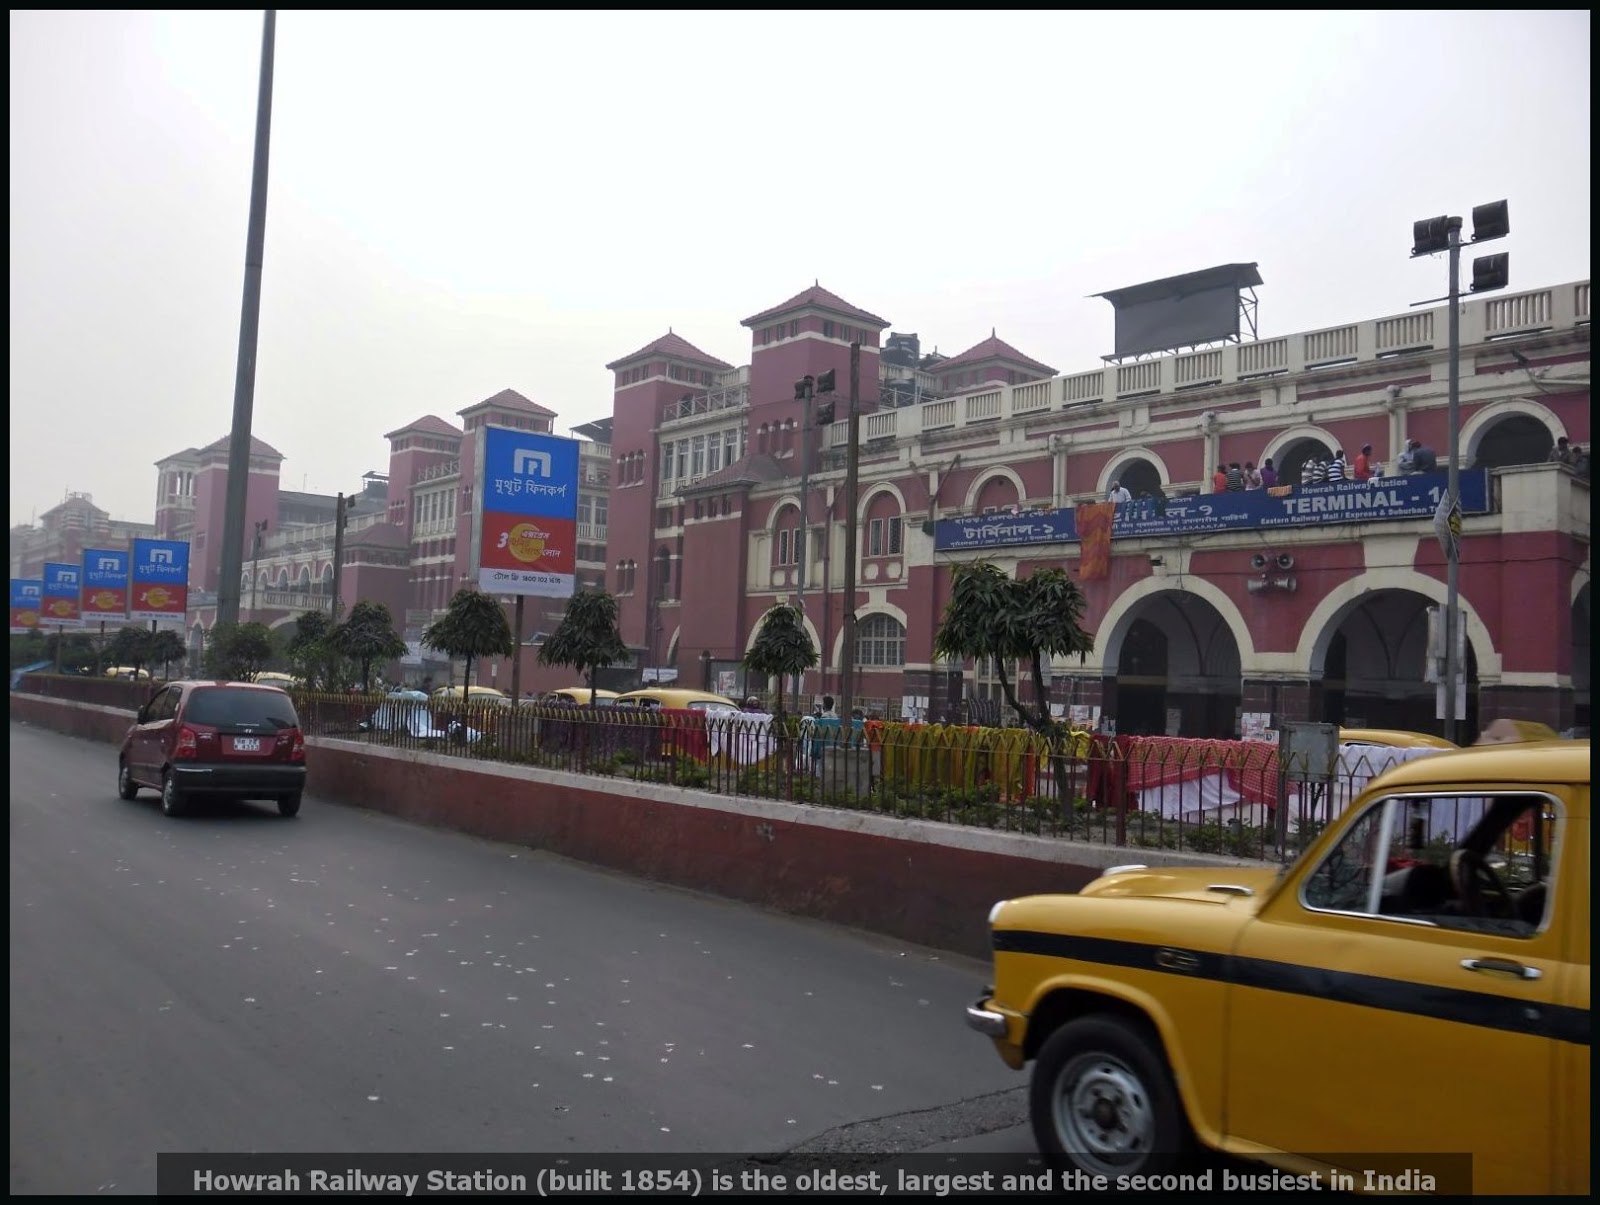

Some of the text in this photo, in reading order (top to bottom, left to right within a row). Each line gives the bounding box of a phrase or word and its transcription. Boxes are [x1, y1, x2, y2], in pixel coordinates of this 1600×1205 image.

[1301, 485, 1334, 495] Howrah
[1337, 482, 1371, 492] Railway
[1282, 490, 1404, 515] TERMINAL
[1428, 486, 1440, 503] 1
[1260, 517, 1289, 525] Eastern
[1291, 514, 1320, 523] Railway
[1345, 508, 1377, 519] Express
[1388, 505, 1427, 516] Suburban
[497, 532, 509, 548] 3
